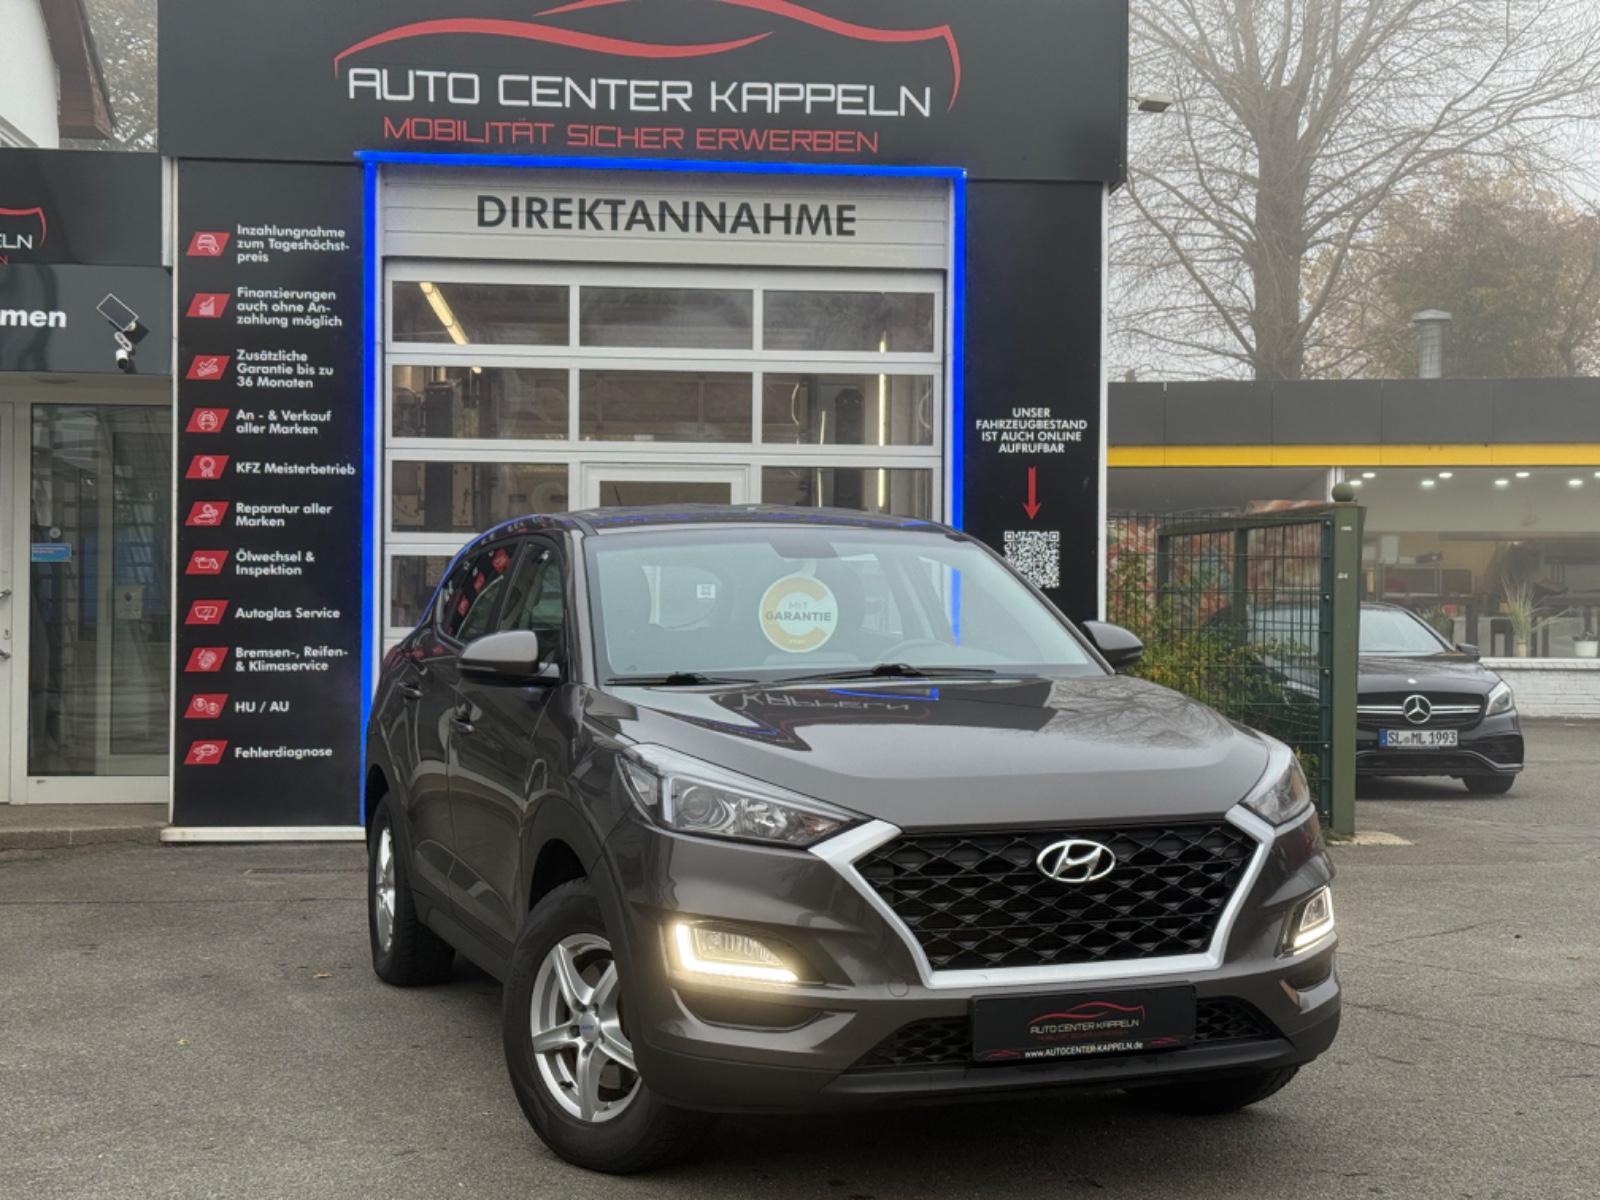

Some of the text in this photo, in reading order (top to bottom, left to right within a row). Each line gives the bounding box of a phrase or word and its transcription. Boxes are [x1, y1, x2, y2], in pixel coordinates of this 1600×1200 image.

[349, 68, 931, 117] AUTO CENTER KAPPELN
[383, 116, 878, 153] MOBILITÄT SICHER ERWERBEN
[477, 194, 857, 237] DIREKTANNAHME
[237, 224, 346, 239] Inzahlungnahme
[237, 238, 350, 252] zum Tageshöchst-
[237, 250, 269, 264] preis
[237, 287, 337, 302] Finanzierungen
[236, 300, 332, 313] auch ohne An-
[236, 313, 343, 329] zahlung möglich
[236, 348, 309, 363] Zusätzliche
[236, 362, 335, 376] Garantie bis zu
[236, 375, 314, 389] 36 Monaten
[236, 409, 255, 421] An
[267, 409, 279, 421] &
[281, 409, 333, 422] Verkauf
[1012, 407, 1051, 418] UNSER
[236, 422, 319, 435] aller Marken
[975, 419, 1088, 430] FAHRZEUGBESTAND
[981, 431, 1082, 442] IST AUCH ONLINE
[998, 443, 1065, 454] AUFRUFBAR
[236, 462, 357, 476] KFZ Meisterbetrieb
[235, 502, 333, 516] Reparatur aller
[235, 515, 285, 527] Marken
[235, 548, 315, 563] Ölwechsel &
[235, 564, 302, 578] Inspektion
[788, 601, 808, 609] MIT
[235, 607, 341, 621] Autoglas Service
[766, 611, 833, 622] GARANTIE
[235, 645, 349, 659] Bremsen-, Reifen-
[235, 659, 329, 672] & Klimaservice
[235, 701, 256, 712] HU
[269, 701, 290, 712] AU
[1388, 731, 1402, 744] SL
[1429, 731, 1457, 744] 1993
[235, 746, 333, 760] Fehlerdiagnose
[1030, 1019, 1140, 1034] AUTO CENTER KAPPELN
